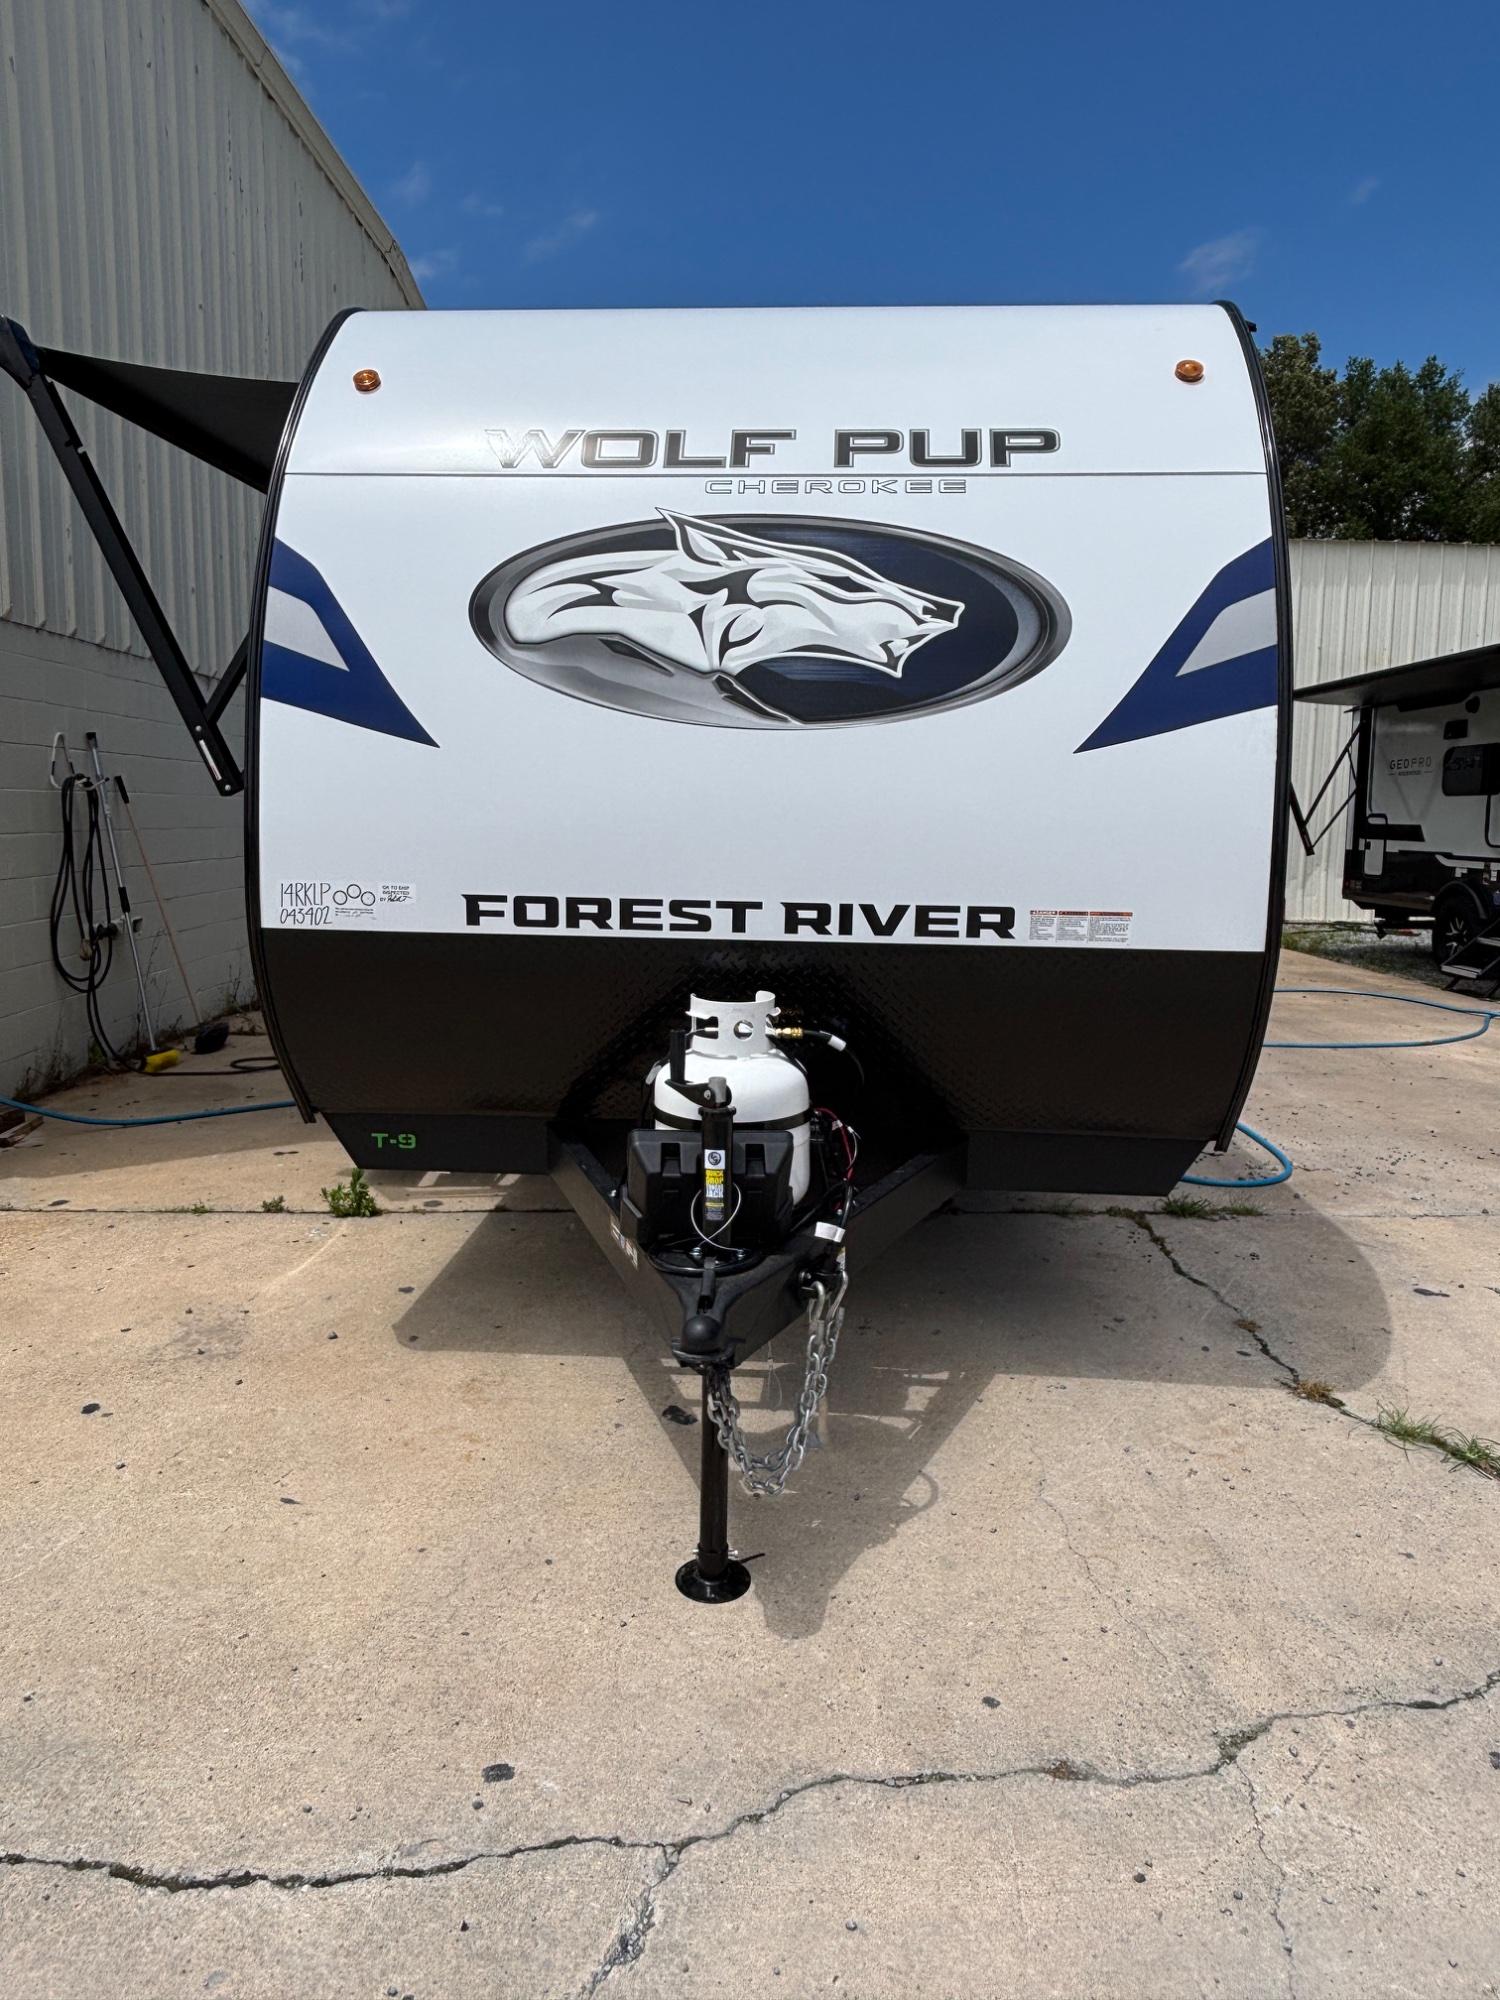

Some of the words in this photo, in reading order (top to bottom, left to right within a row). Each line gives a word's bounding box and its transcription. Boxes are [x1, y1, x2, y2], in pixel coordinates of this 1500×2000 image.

[484, 428, 797, 469] WOLF
[833, 428, 1061, 468] PUP
[704, 479, 967, 495] CHEROKEE
[461, 894, 763, 933] FOREST
[780, 901, 1016, 939] RIVER
